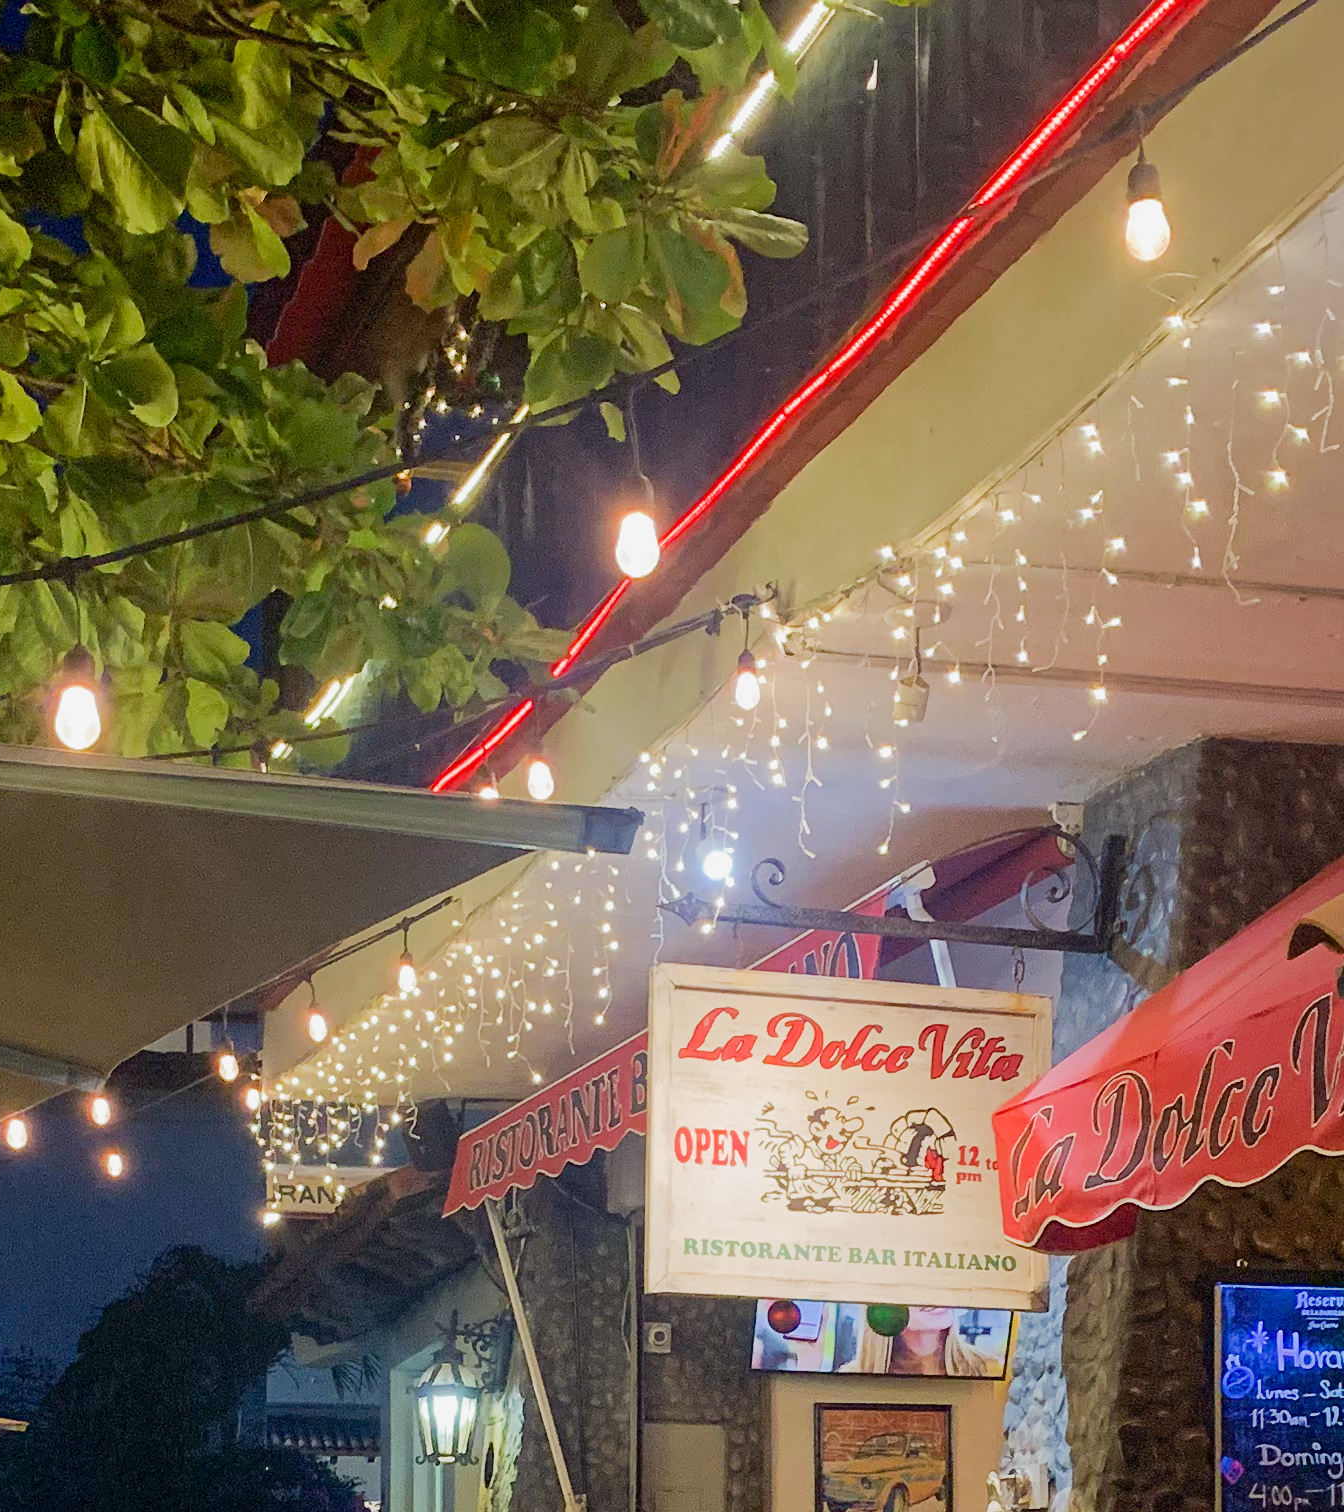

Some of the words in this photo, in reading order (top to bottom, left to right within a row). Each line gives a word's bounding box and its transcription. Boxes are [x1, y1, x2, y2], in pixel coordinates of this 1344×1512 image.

[678, 1006, 758, 1062] La
[762, 1012, 914, 1073] Dolce
[918, 1024, 1024, 1081] Vita
[469, 1065, 623, 1193] RISTORANTE
[674, 1126, 750, 1168] OPEN
[1011, 1104, 1077, 1222] La
[1083, 1039, 1282, 1192] Dolce
[956, 1145, 980, 1168] 12
[956, 1171, 982, 1184] pm
[683, 1238, 842, 1263] RISTORANTE
[848, 1247, 897, 1267] BAR
[904, 1250, 1017, 1272] ITALIANO
[1256, 1379, 1299, 1400] Lunes
